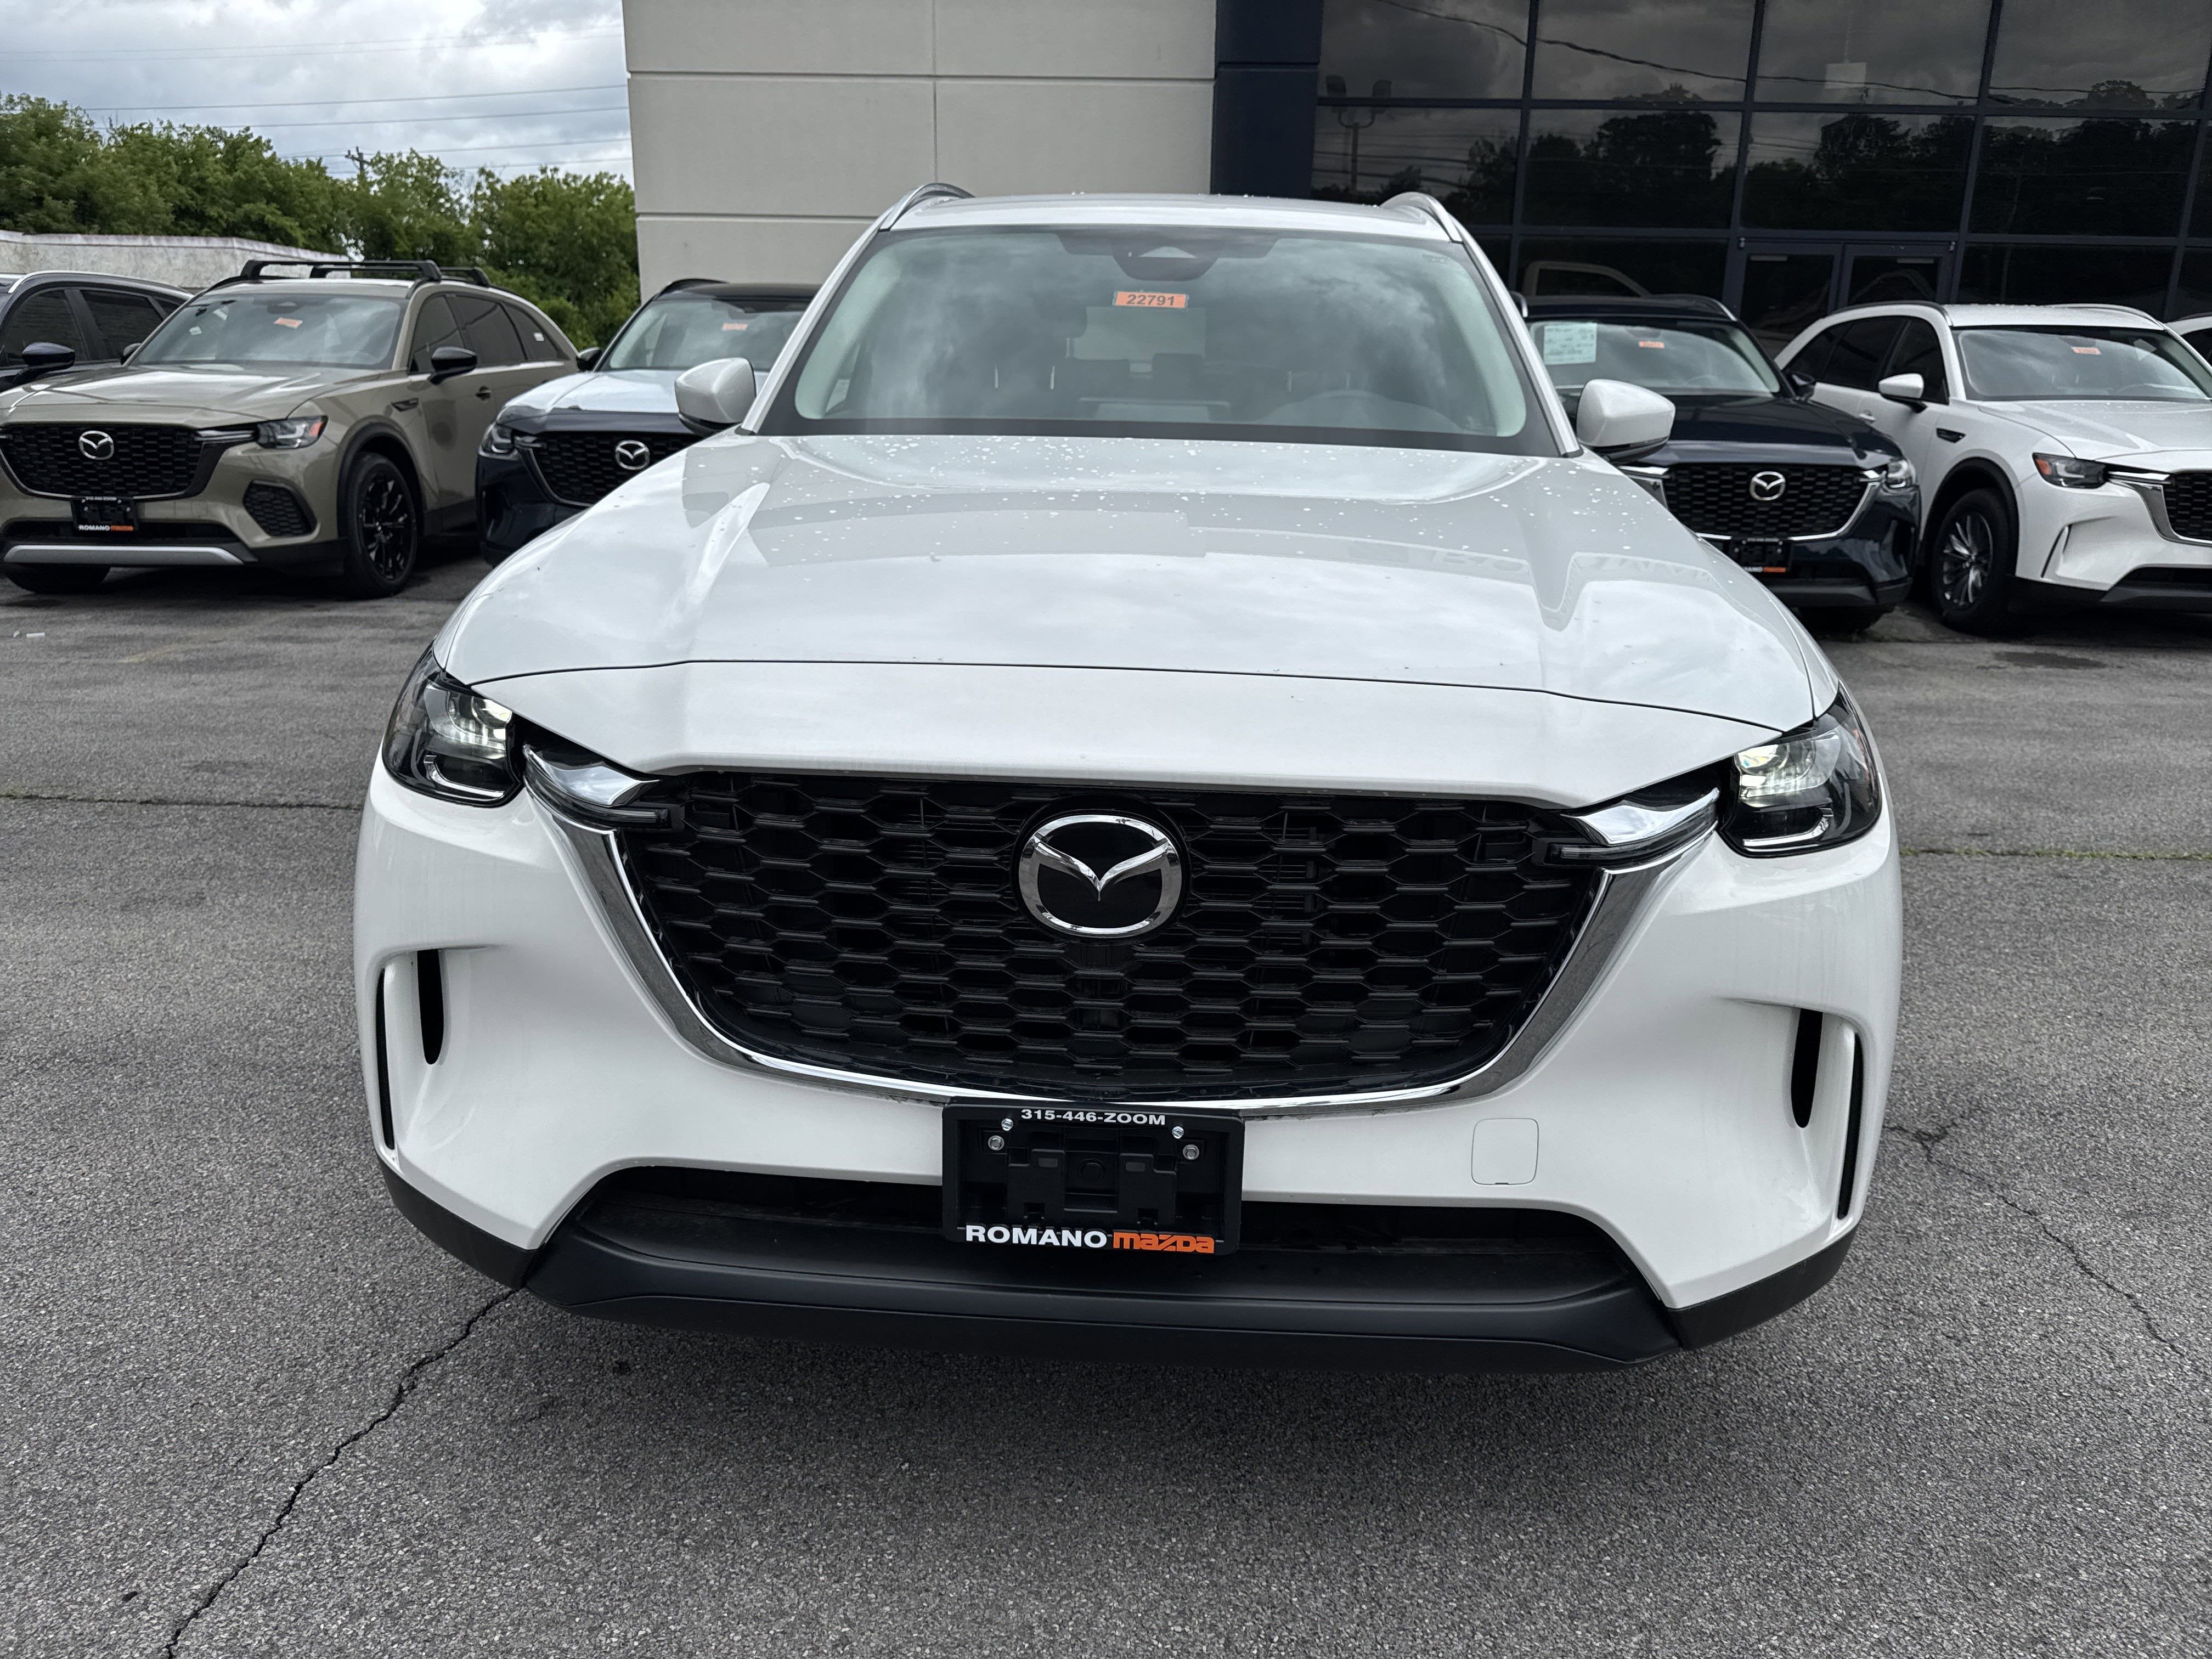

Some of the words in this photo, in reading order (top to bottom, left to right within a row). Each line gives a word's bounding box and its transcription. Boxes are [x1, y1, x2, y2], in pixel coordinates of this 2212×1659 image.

[1126, 294, 1175, 306] 22791
[1021, 1109, 1165, 1125] 315-446-ZOOM
[966, 1224, 1107, 1248] ROMANO
